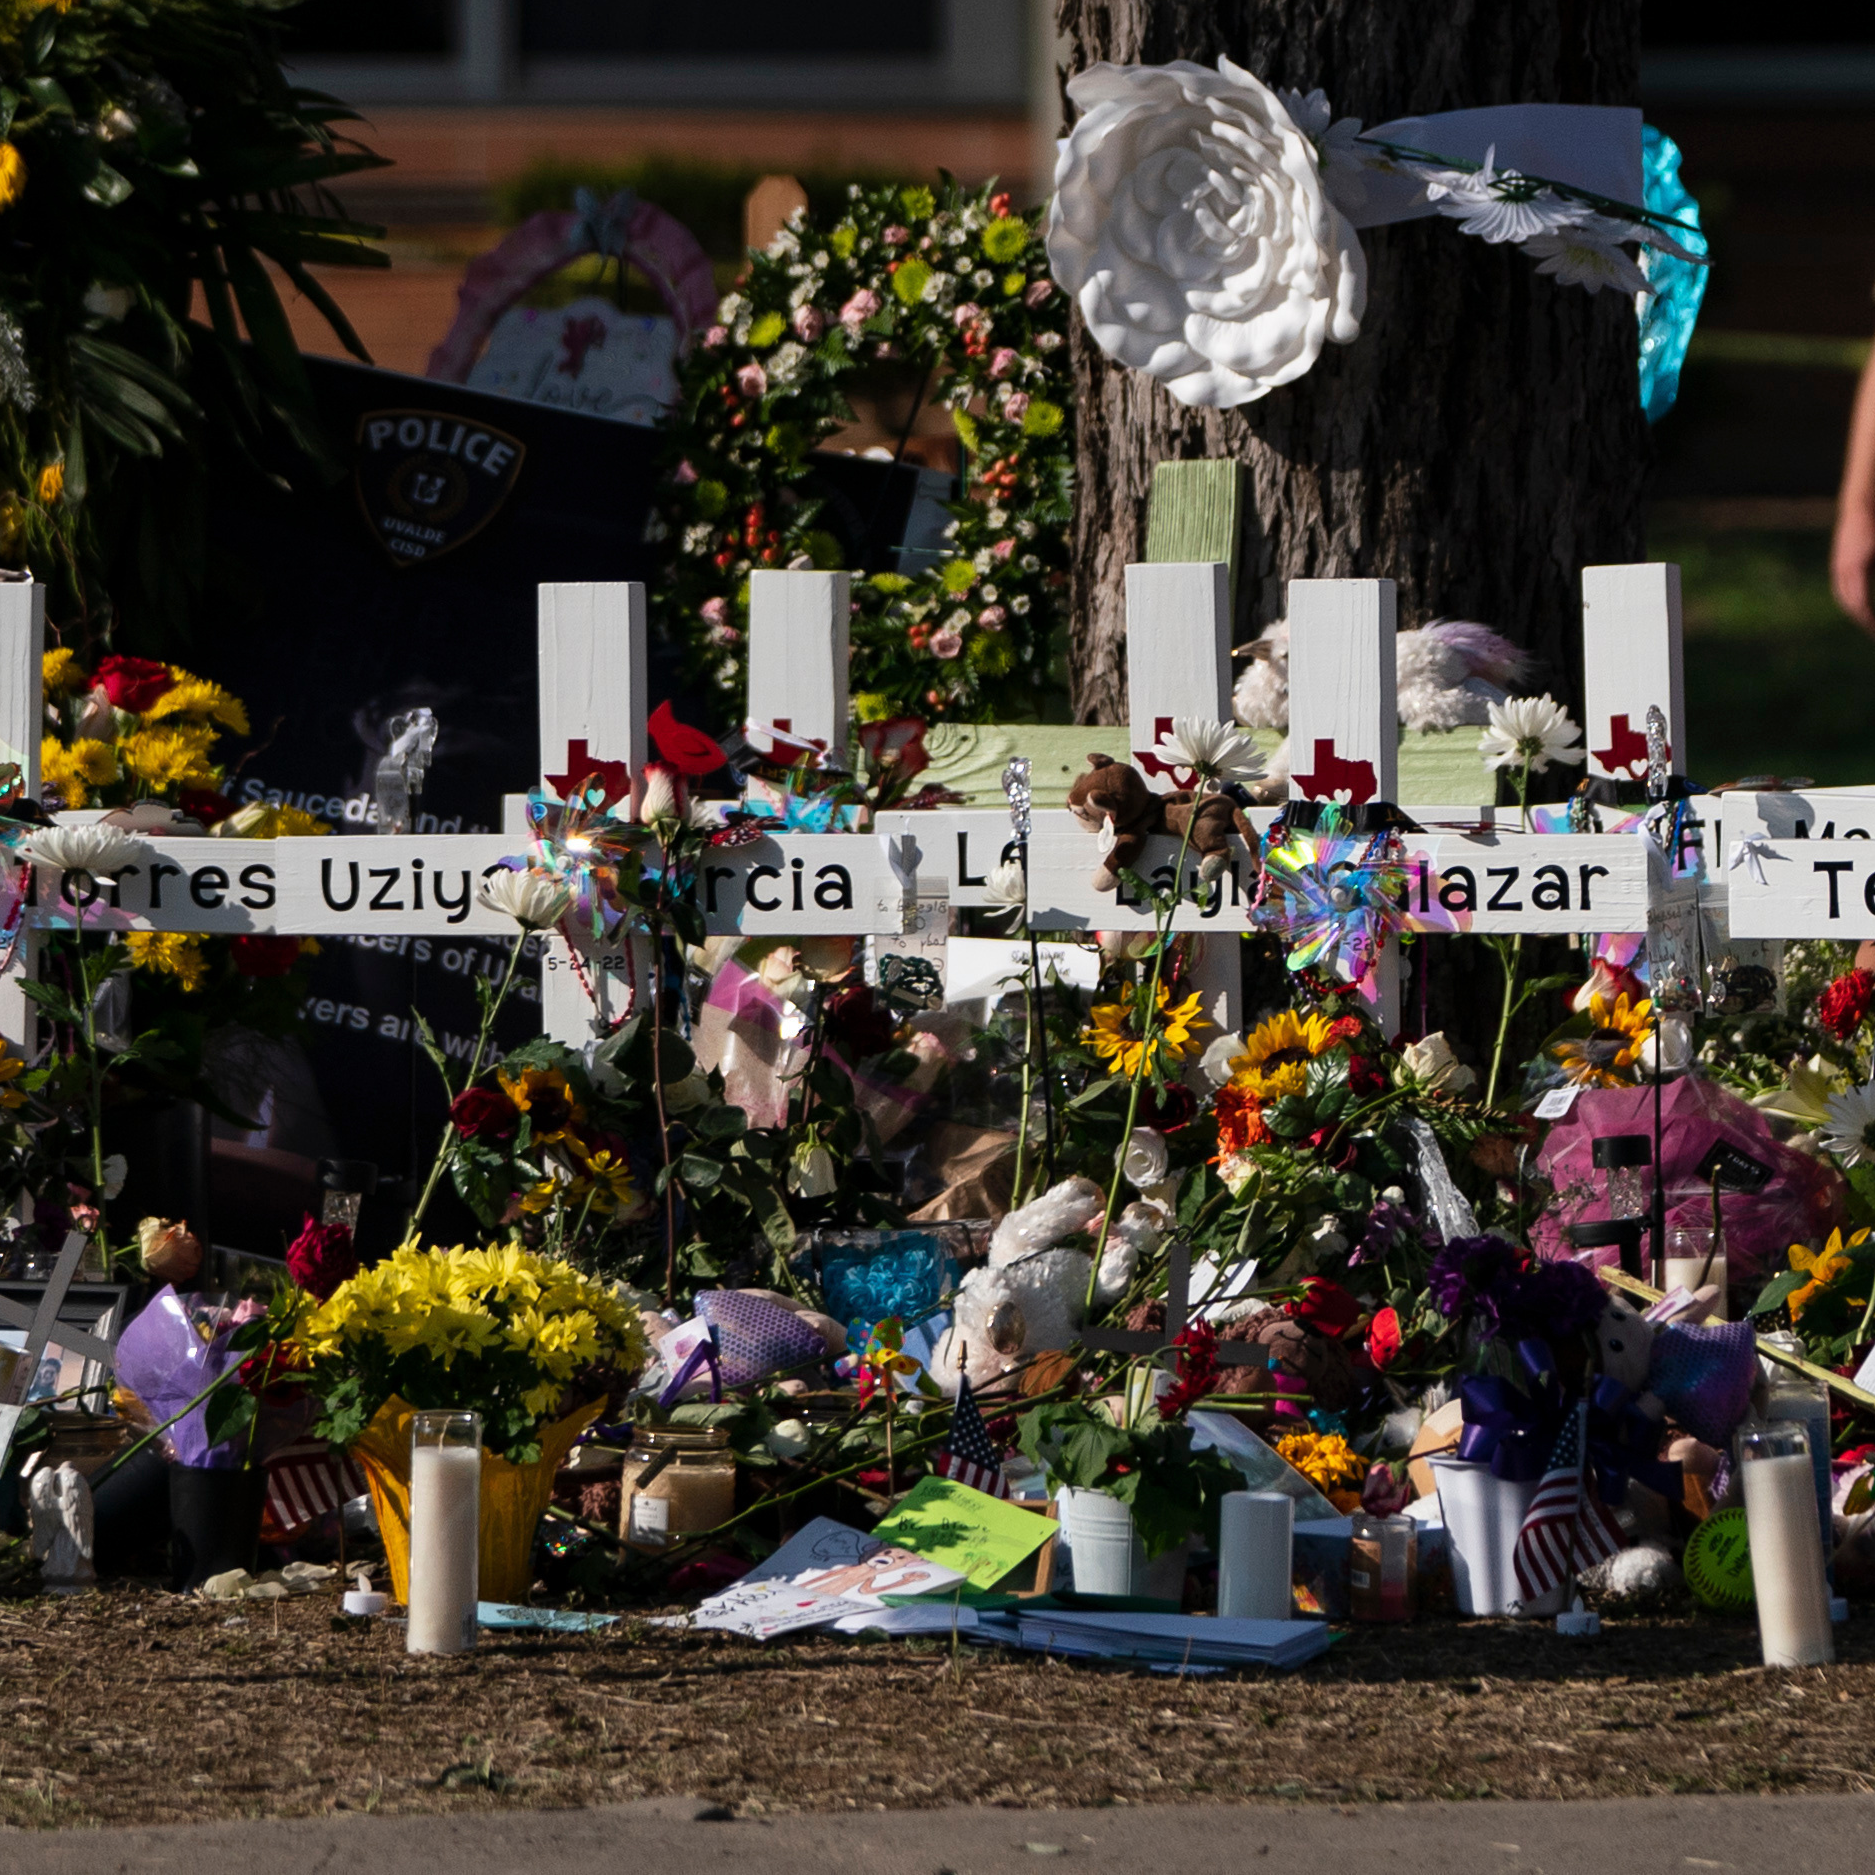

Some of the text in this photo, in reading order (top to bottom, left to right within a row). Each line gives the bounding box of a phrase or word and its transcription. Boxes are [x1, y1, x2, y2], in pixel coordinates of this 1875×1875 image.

[366, 417, 517, 478] POLICE
[382, 515, 447, 546] UVALDE
[390, 536, 427, 559] CISD
[441, 947, 478, 977] of
[548, 955, 626, 972] 5-24-22
